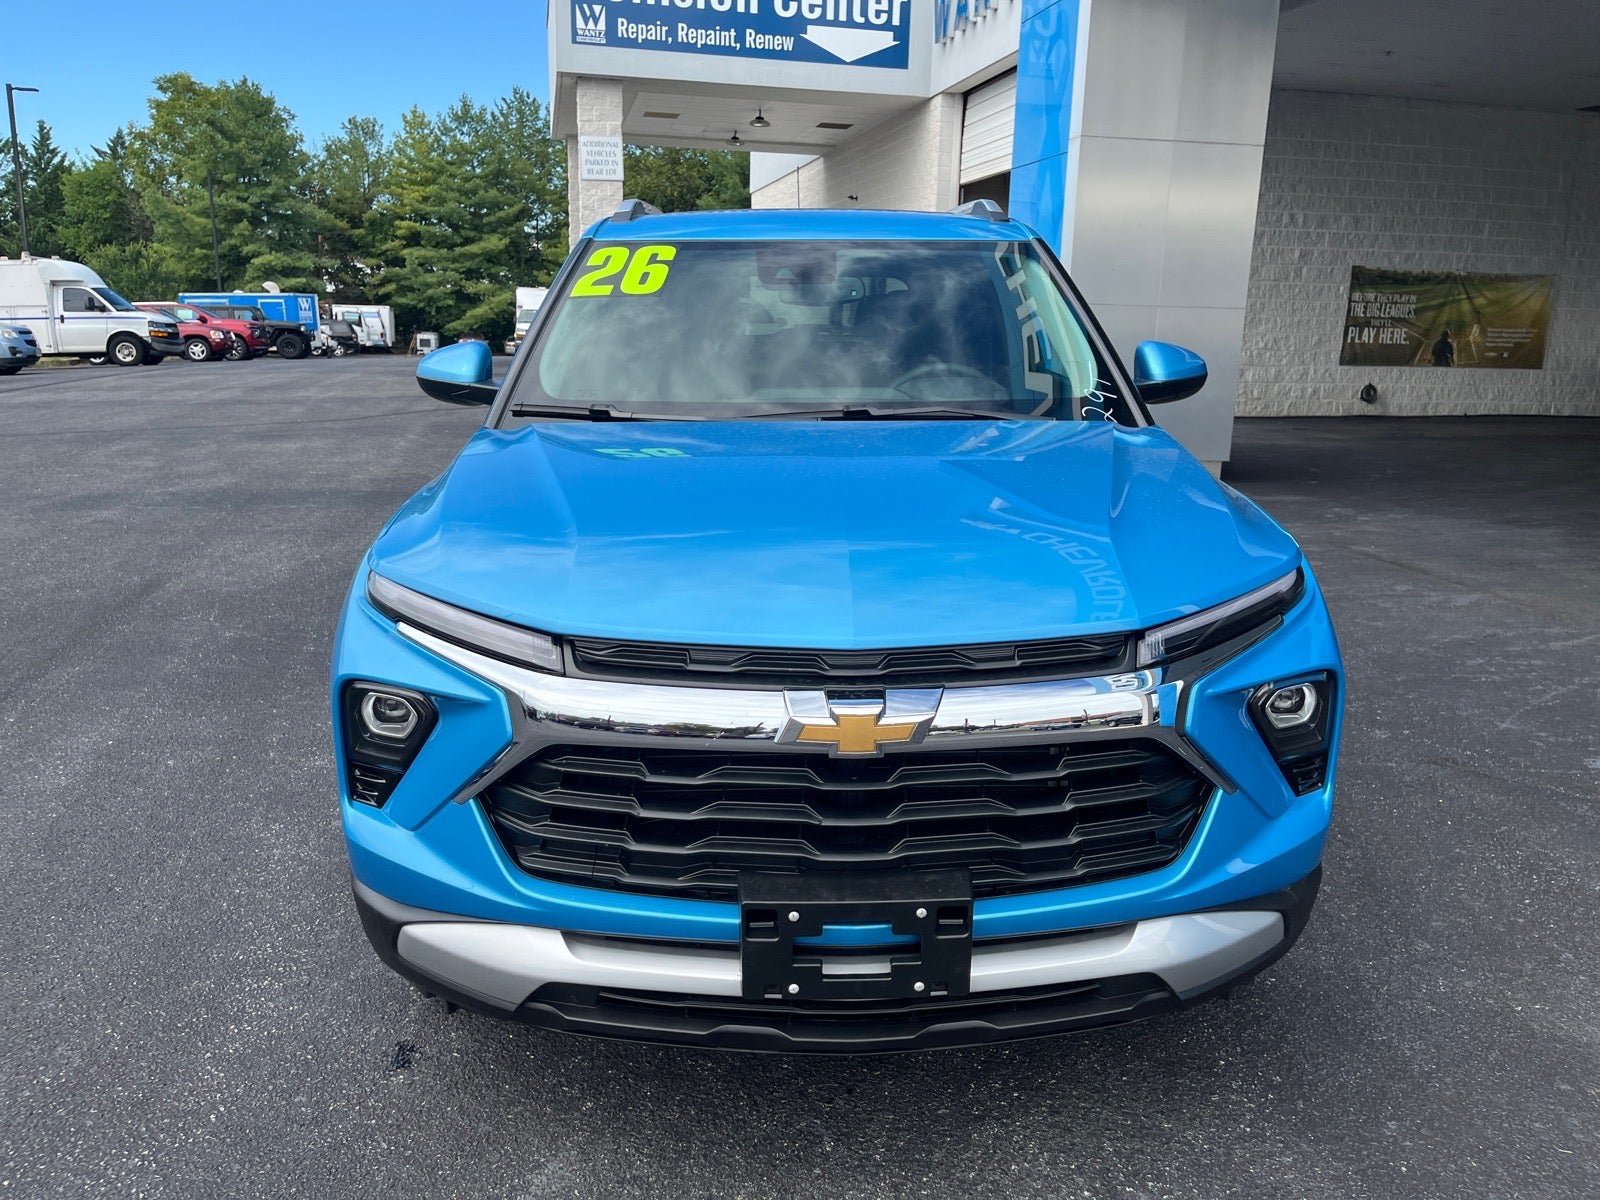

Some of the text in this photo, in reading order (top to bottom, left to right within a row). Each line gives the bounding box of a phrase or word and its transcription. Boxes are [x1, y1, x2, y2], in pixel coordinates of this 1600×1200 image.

[576, 28, 606, 38] WANTZ
[617, 17, 795, 52] Repair, Repaint, Renew
[586, 149, 617, 158] VEHICLES
[569, 245, 677, 298] 26
[1351, 292, 1417, 303] BEFORE THEY PLAY IN
[1350, 303, 1416, 319] THE BIG LEAGUES,
[1347, 326, 1410, 345] PLAY HERE.
